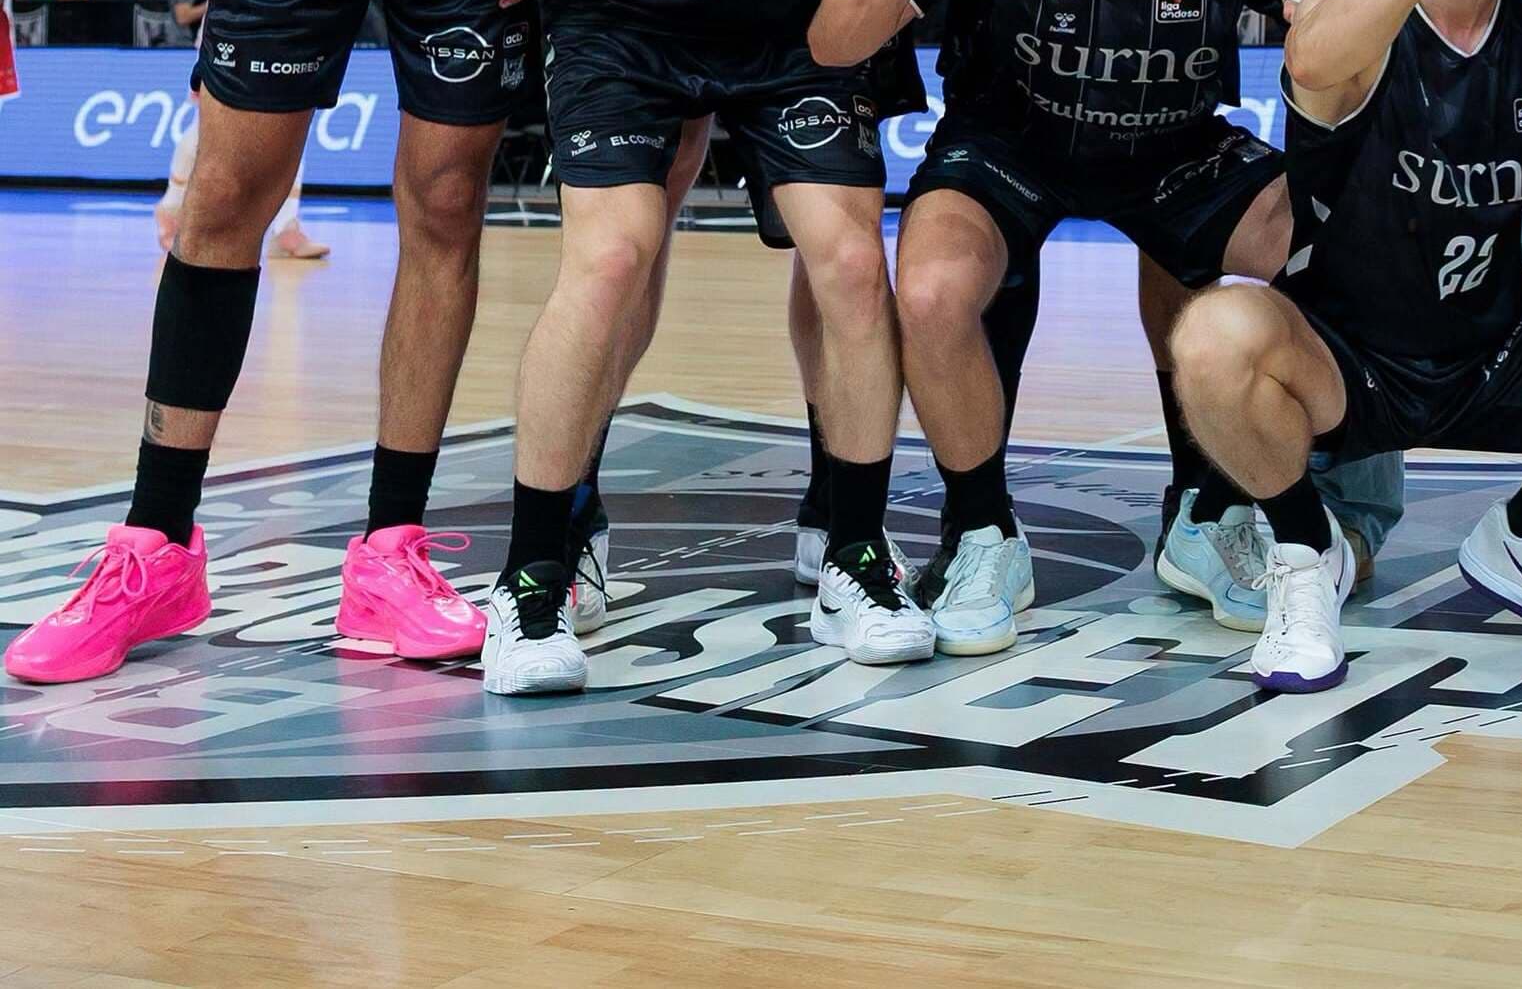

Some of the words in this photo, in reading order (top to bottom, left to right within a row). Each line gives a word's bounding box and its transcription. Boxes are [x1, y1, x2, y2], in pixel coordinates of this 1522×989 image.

[1160, 1, 1180, 11] liga
[1160, 10, 1200, 19] endesa
[1014, 32, 1220, 84] surne
[250, 61, 268, 73] EL
[271, 61, 320, 75] CORREO
[777, 113, 852, 133] NISSAN
[609, 134, 628, 147] EL
[1437, 233, 1499, 301] 22
